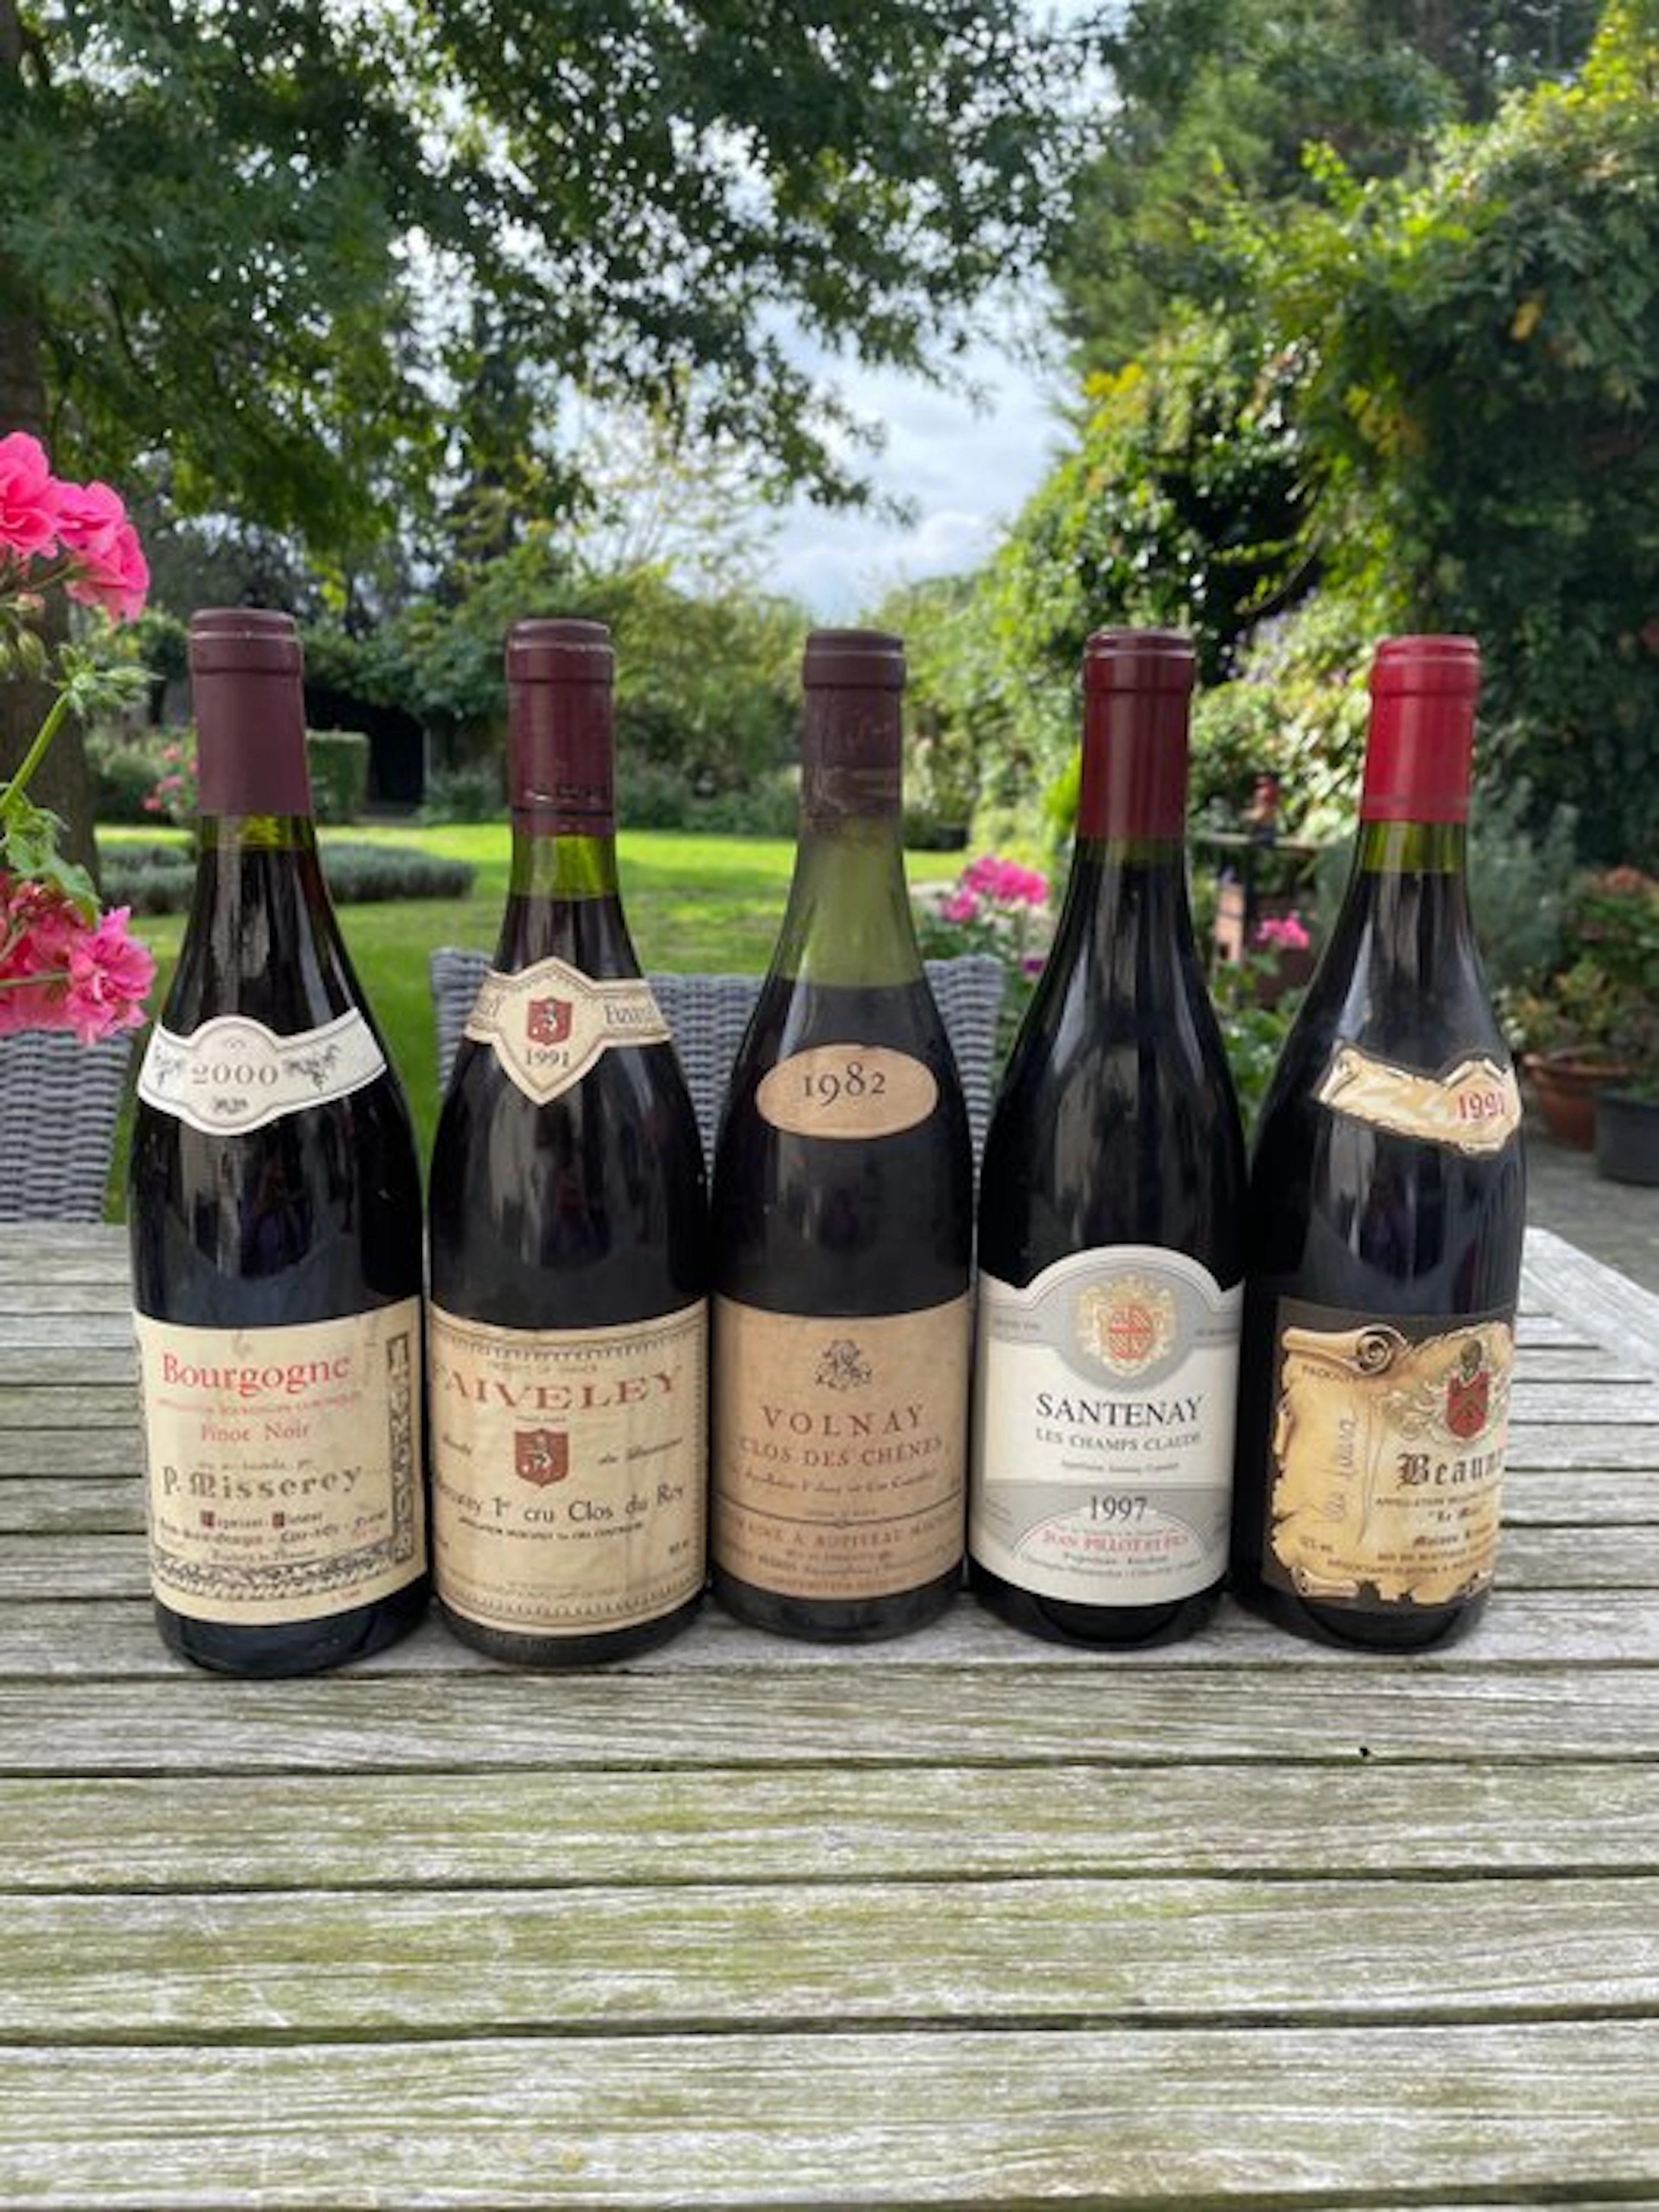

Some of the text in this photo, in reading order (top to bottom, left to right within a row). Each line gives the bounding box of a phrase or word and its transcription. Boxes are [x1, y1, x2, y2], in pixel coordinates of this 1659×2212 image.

[525, 1048, 569, 1069] 1991
[192, 1064, 278, 1085] 2000
[803, 1062, 886, 1106] 1982
[162, 1351, 350, 1397] Bourgogne
[761, 1404, 924, 1437] VOLNAY
[1036, 1393, 1202, 1427] SANTENAY
[200, 1422, 311, 1443] Pinot Noir
[739, 1436, 792, 1464] CLOS
[804, 1449, 849, 1467] DES
[188, 1465, 362, 1502] Misserey
[524, 1507, 555, 1522] cru
[568, 1500, 613, 1522] Clos
[626, 1493, 649, 1515] du
[1090, 1496, 1147, 1521] 1997
